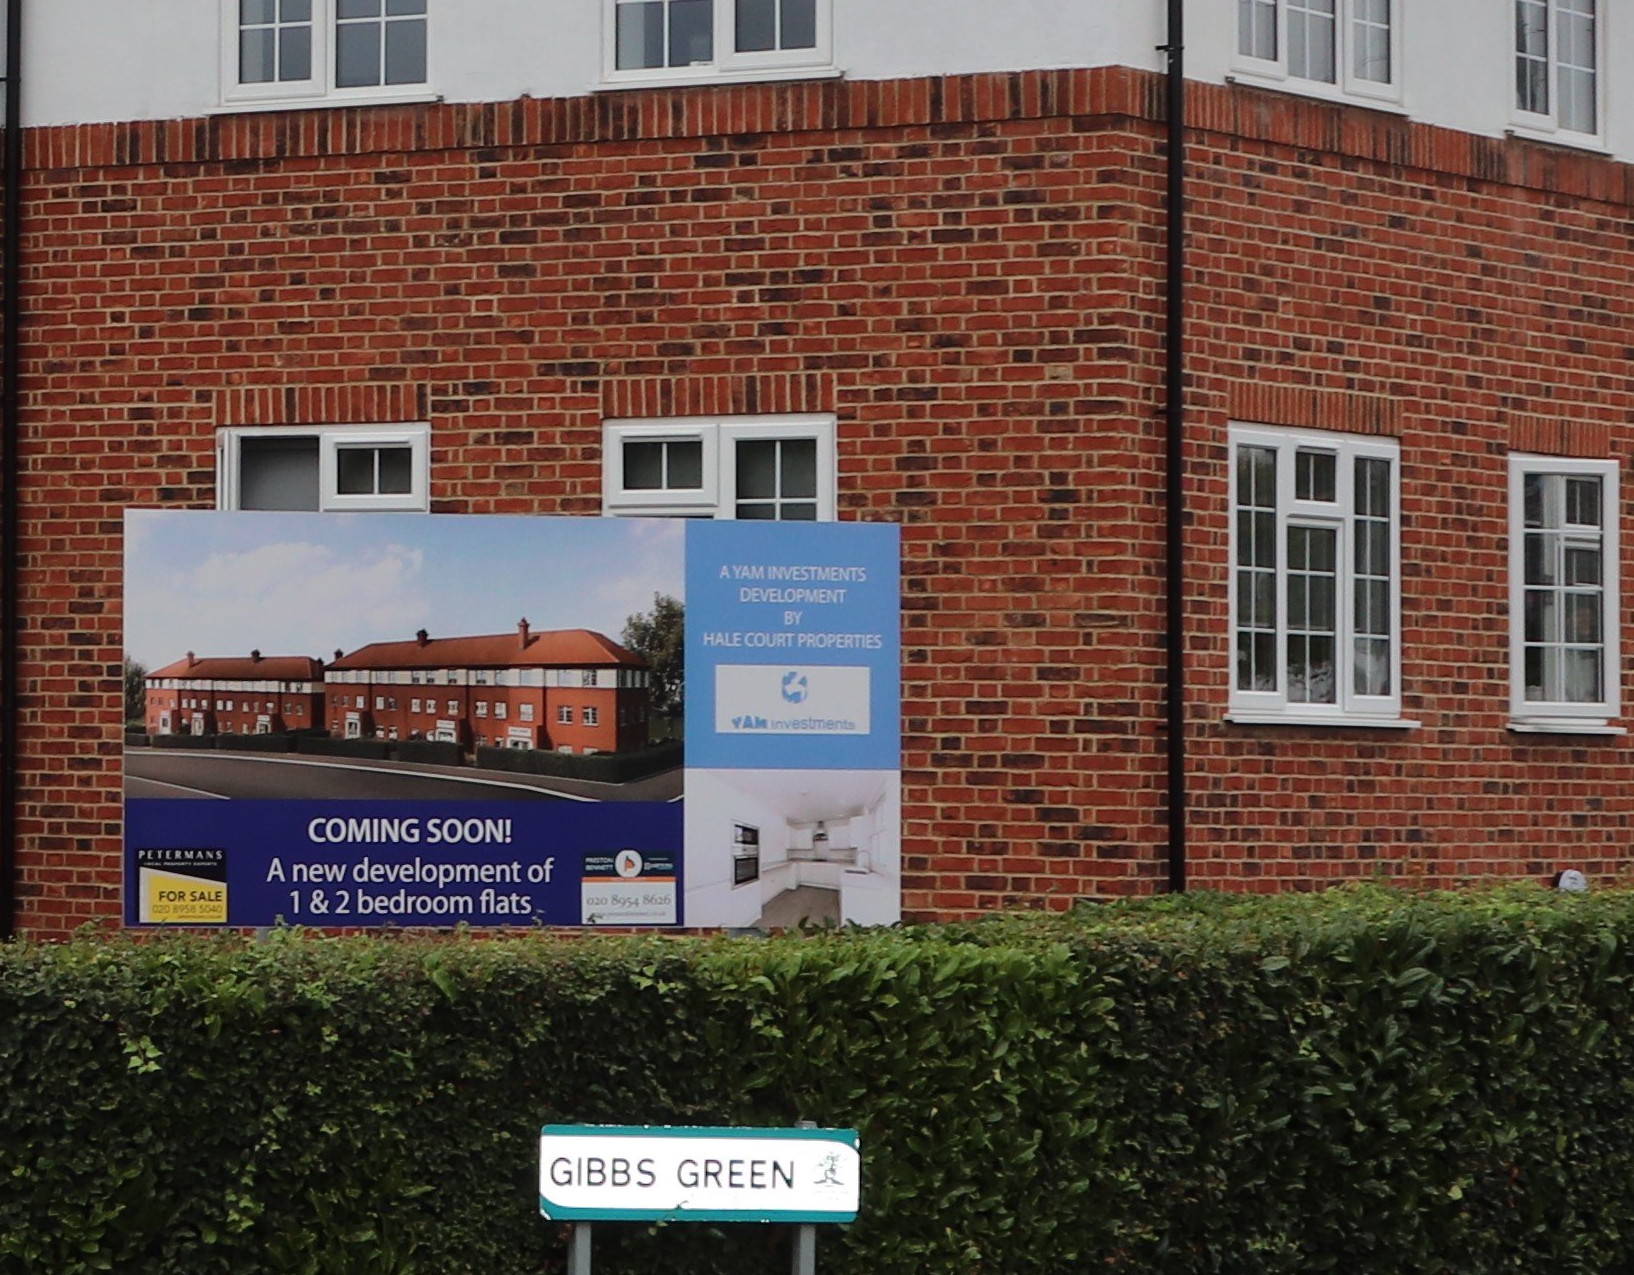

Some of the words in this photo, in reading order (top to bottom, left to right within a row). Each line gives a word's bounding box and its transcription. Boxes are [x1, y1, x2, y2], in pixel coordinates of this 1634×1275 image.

[719, 565, 730, 579] A
[733, 566, 764, 580] YAM
[768, 566, 866, 582] INVESTMENTS
[740, 588, 847, 604] DEVELOPMENT
[784, 611, 803, 625] BY
[703, 632, 741, 647] HALE
[744, 633, 794, 648] COURT
[798, 634, 882, 650] PROPERTIES
[308, 817, 420, 843] COMING
[426, 819, 512, 844] SOON!
[138, 850, 223, 860] PETERMANS
[266, 857, 285, 883] A
[292, 862, 347, 883] new
[352, 857, 521, 888] development
[527, 857, 554, 884] of
[159, 891, 186, 901] FOR
[190, 891, 222, 902] SALE
[289, 890, 300, 914] 1
[309, 889, 329, 914] &
[335, 890, 350, 914] 2
[357, 889, 473, 914] bedroom
[480, 889, 532, 914] flats
[586, 896, 608, 906] 020
[611, 894, 639, 908] 8954
[643, 894, 671, 905] 8626
[152, 904, 170, 914] 020
[550, 1157, 657, 1188] GIBBS
[677, 1159, 794, 1189] GREEN
